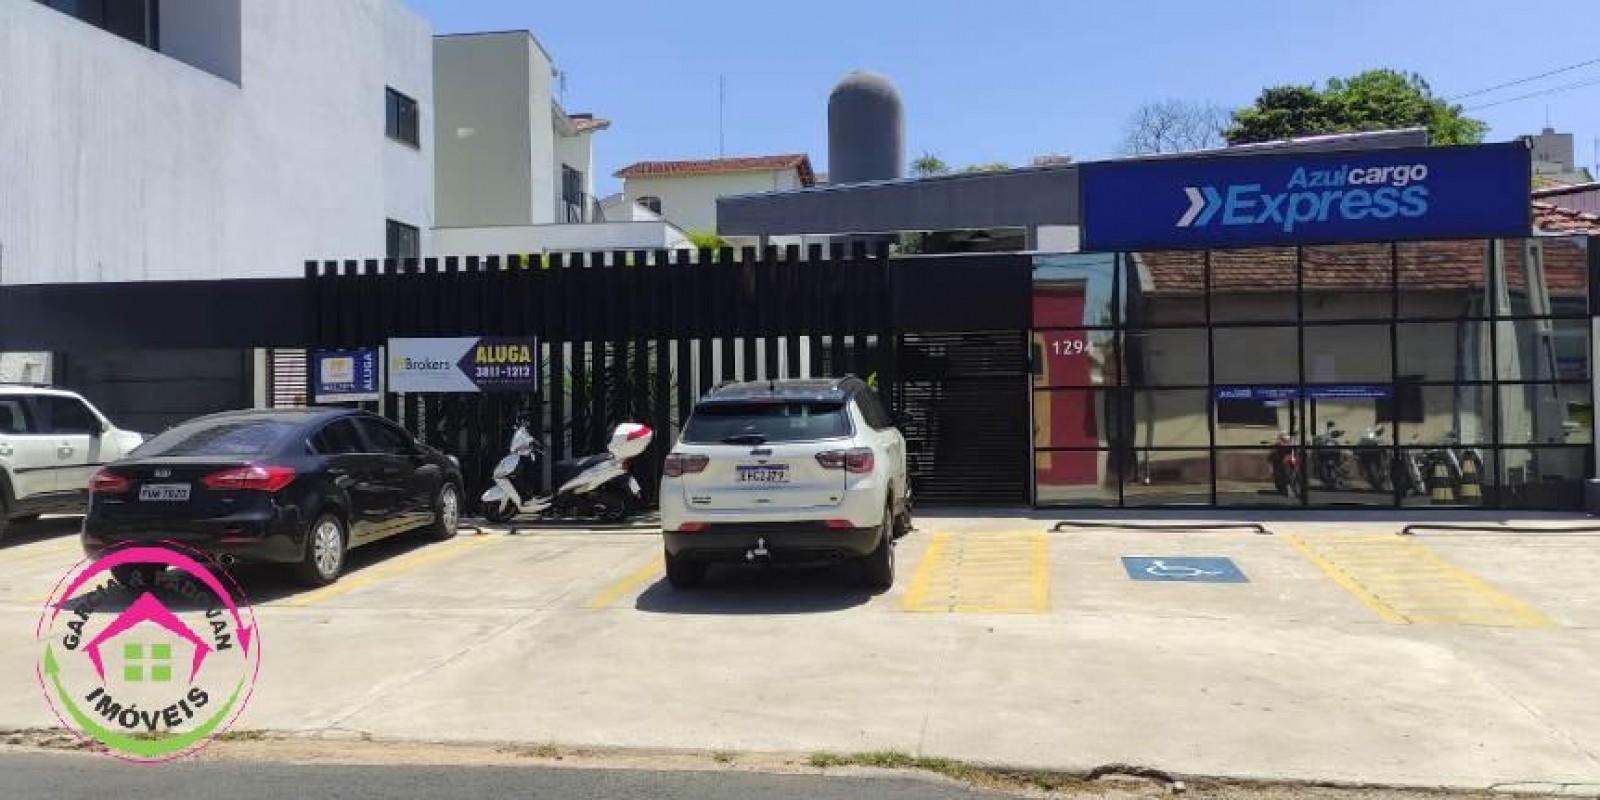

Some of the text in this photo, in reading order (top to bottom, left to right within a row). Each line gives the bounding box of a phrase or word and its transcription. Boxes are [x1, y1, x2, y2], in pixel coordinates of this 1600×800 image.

[1221, 184, 1430, 233] Express
[475, 345, 531, 363] ALUGA
[1051, 340, 1095, 356] 1294
[362, 352, 373, 391] ALUGA
